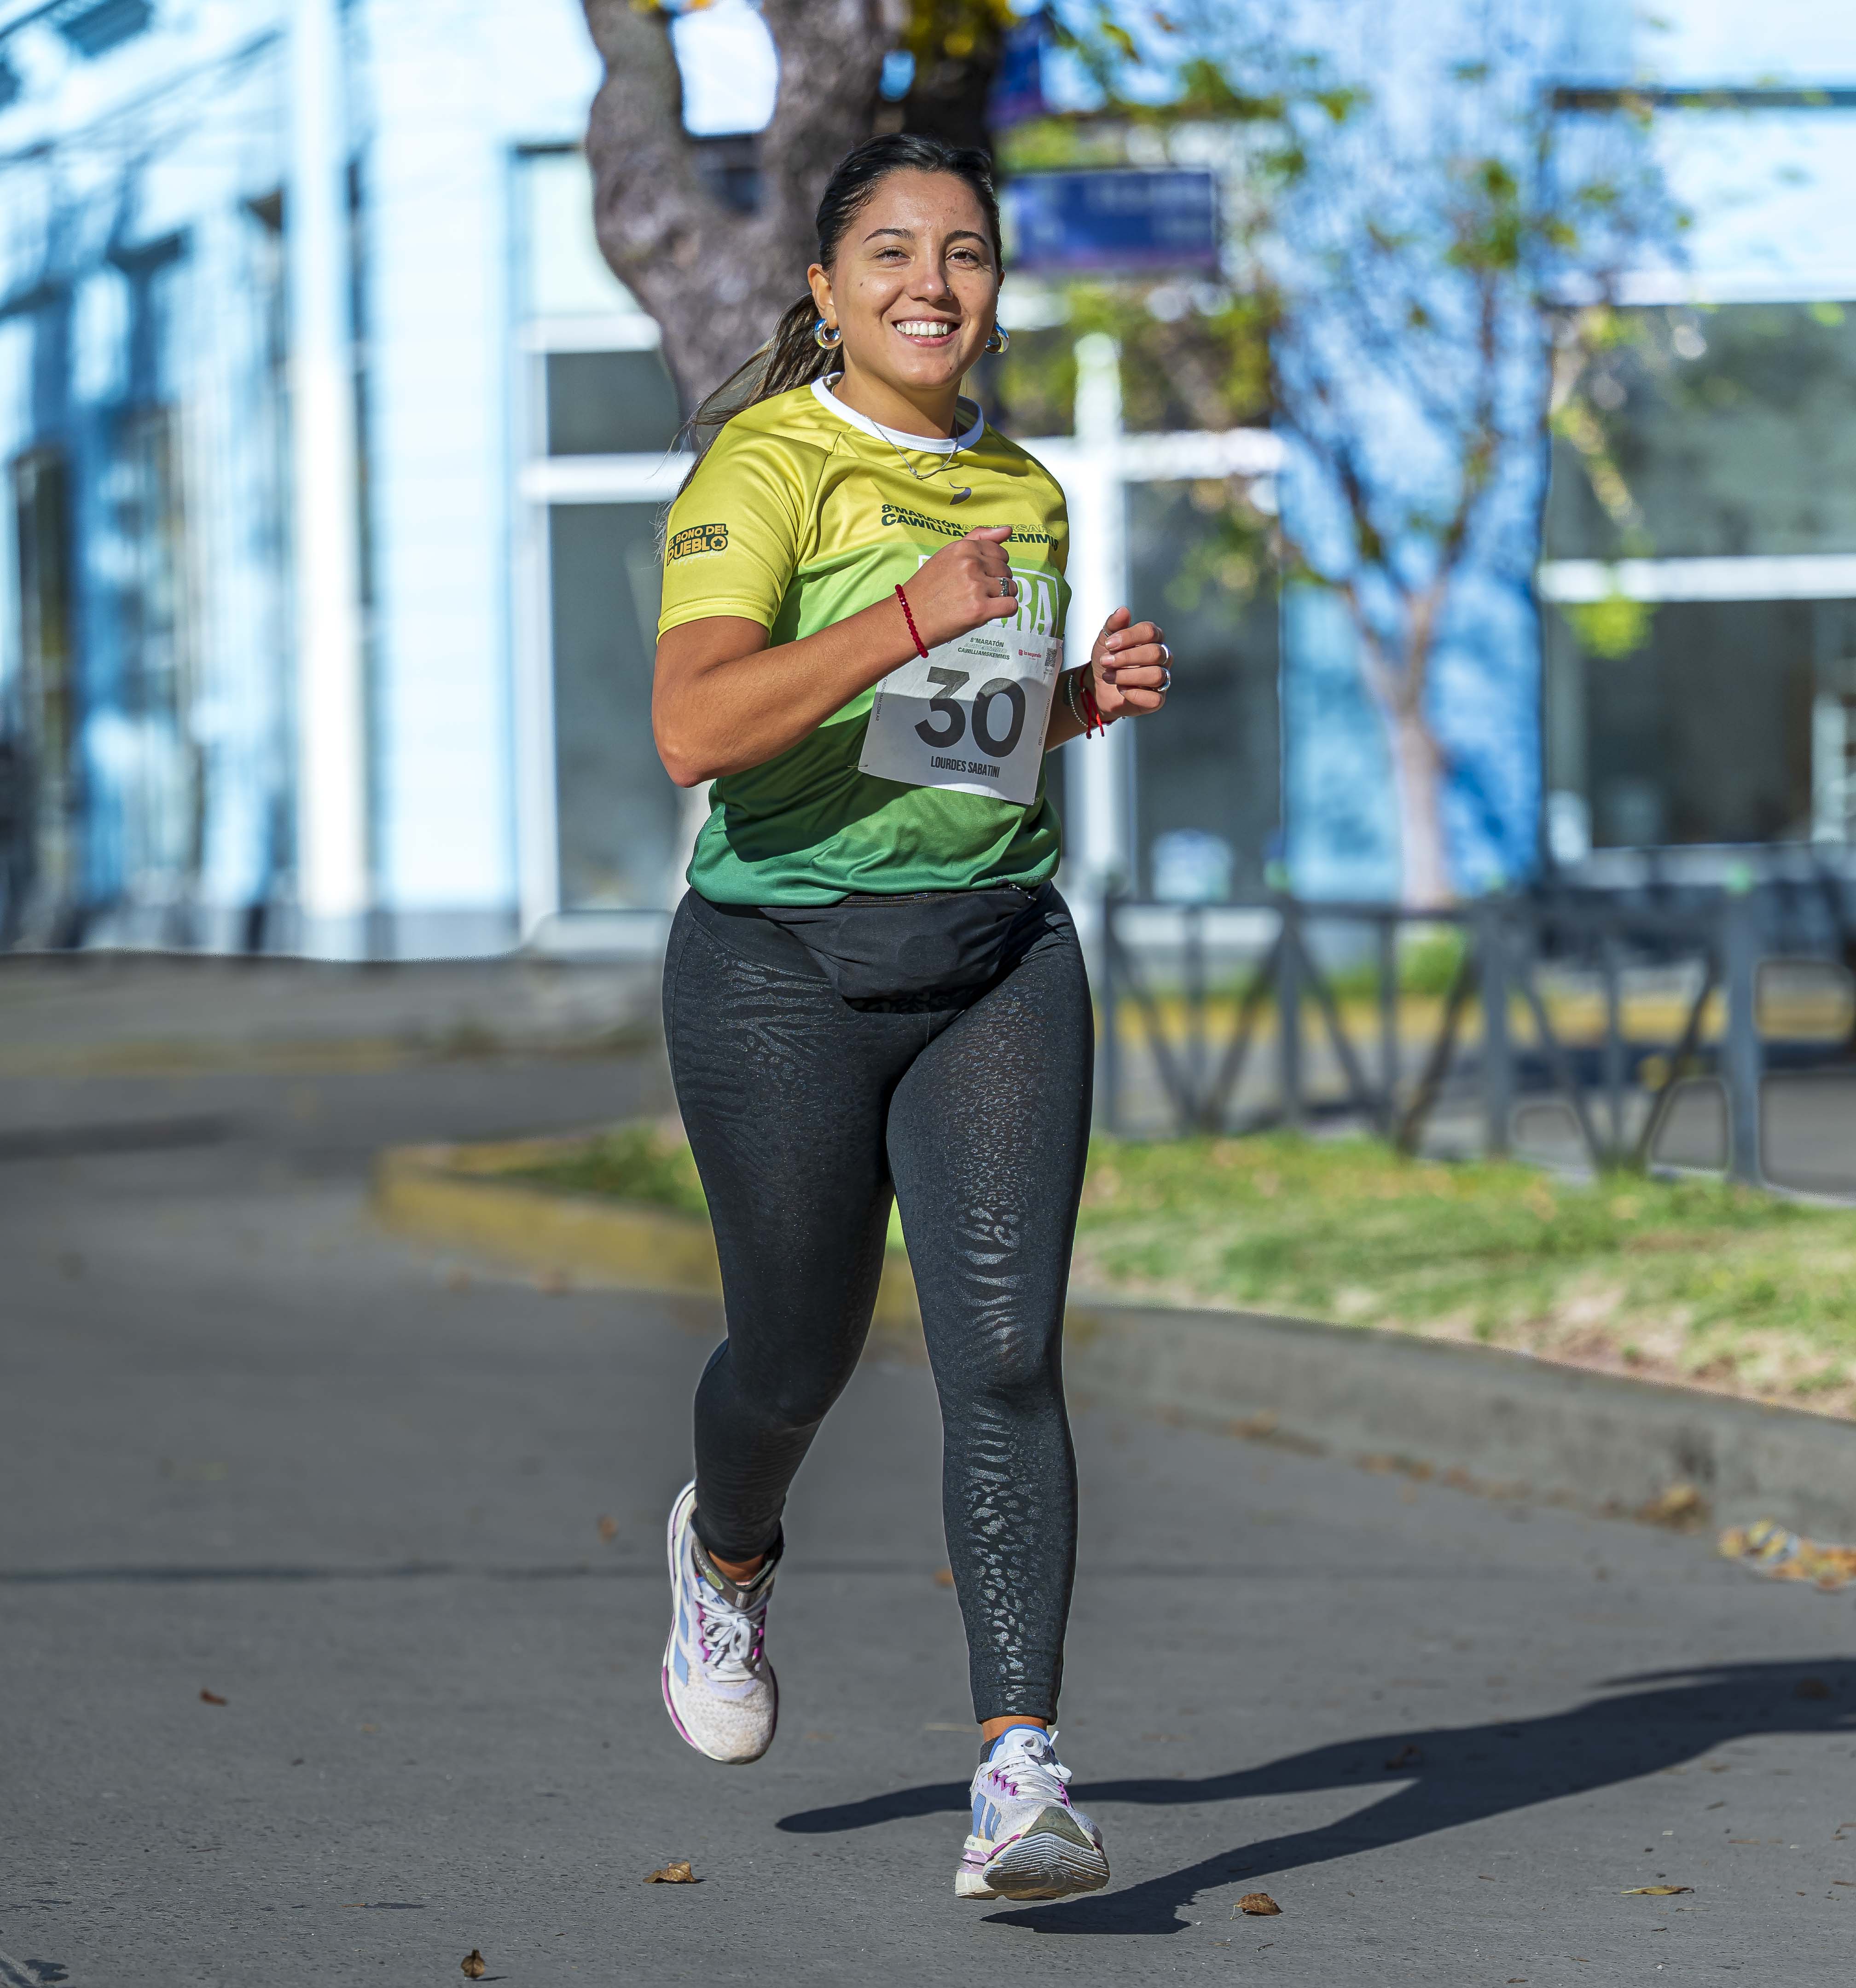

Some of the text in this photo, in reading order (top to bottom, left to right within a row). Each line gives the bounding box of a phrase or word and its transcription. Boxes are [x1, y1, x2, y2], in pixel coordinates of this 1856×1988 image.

[669, 525, 726, 548] EL BONO DEL
[667, 535, 726, 565] PUEBLO
[957, 647, 1010, 660] CAWILLIAMSKEMMIS
[914, 666, 1026, 759] 30
[930, 755, 1000, 778] LOURDES SABATINI
